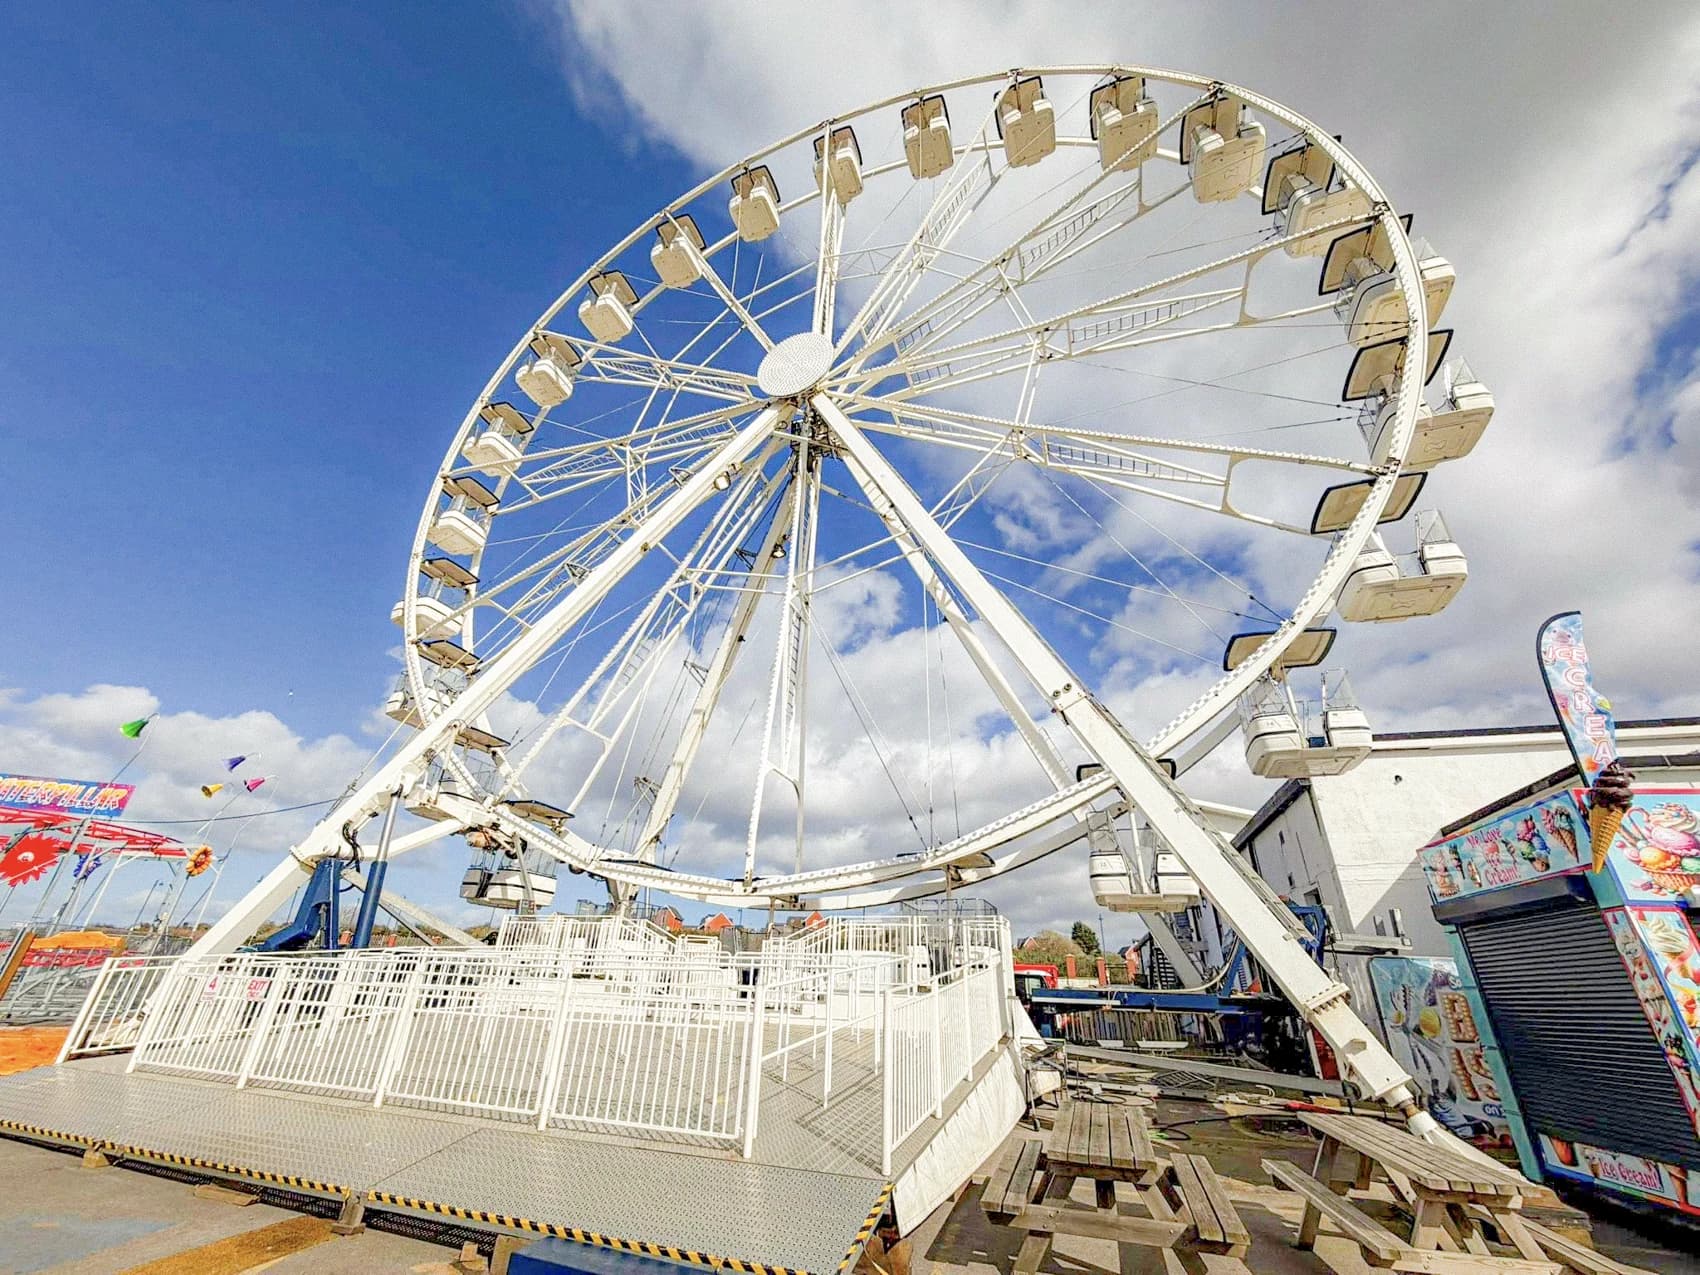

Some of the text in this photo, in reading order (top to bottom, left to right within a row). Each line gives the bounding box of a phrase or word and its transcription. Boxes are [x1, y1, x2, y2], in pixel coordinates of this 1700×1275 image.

[1547, 645, 1588, 663] ICE
[1564, 668, 1614, 767] CREA
[0, 776, 129, 810] ATERPILLAR
[247, 978, 268, 991] EXIT
